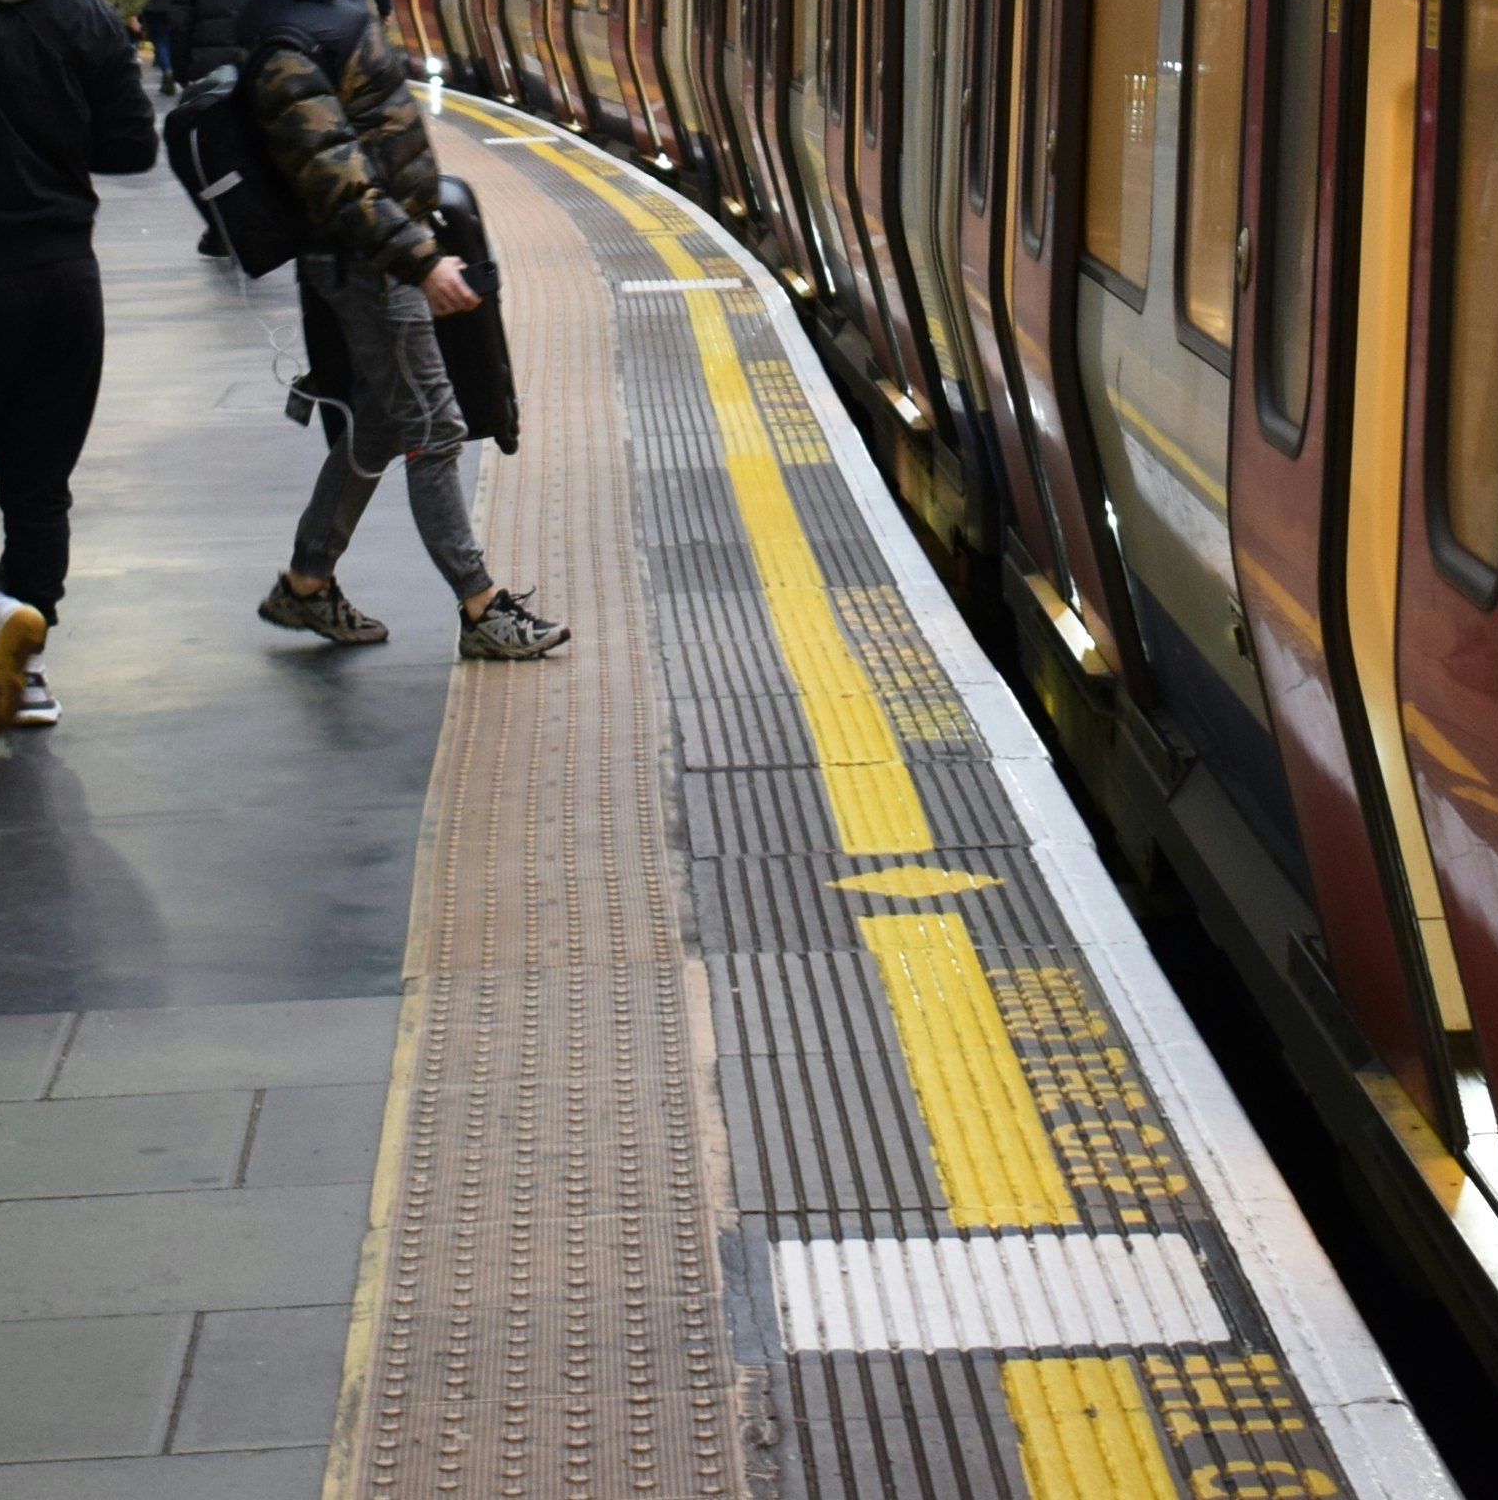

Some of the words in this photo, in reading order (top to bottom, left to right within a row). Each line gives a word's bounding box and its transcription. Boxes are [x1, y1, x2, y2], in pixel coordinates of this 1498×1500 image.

[1019, 1046, 1147, 1113] THE
[1052, 1119, 1189, 1198] GAP
[1143, 1353, 1307, 1442] THE
